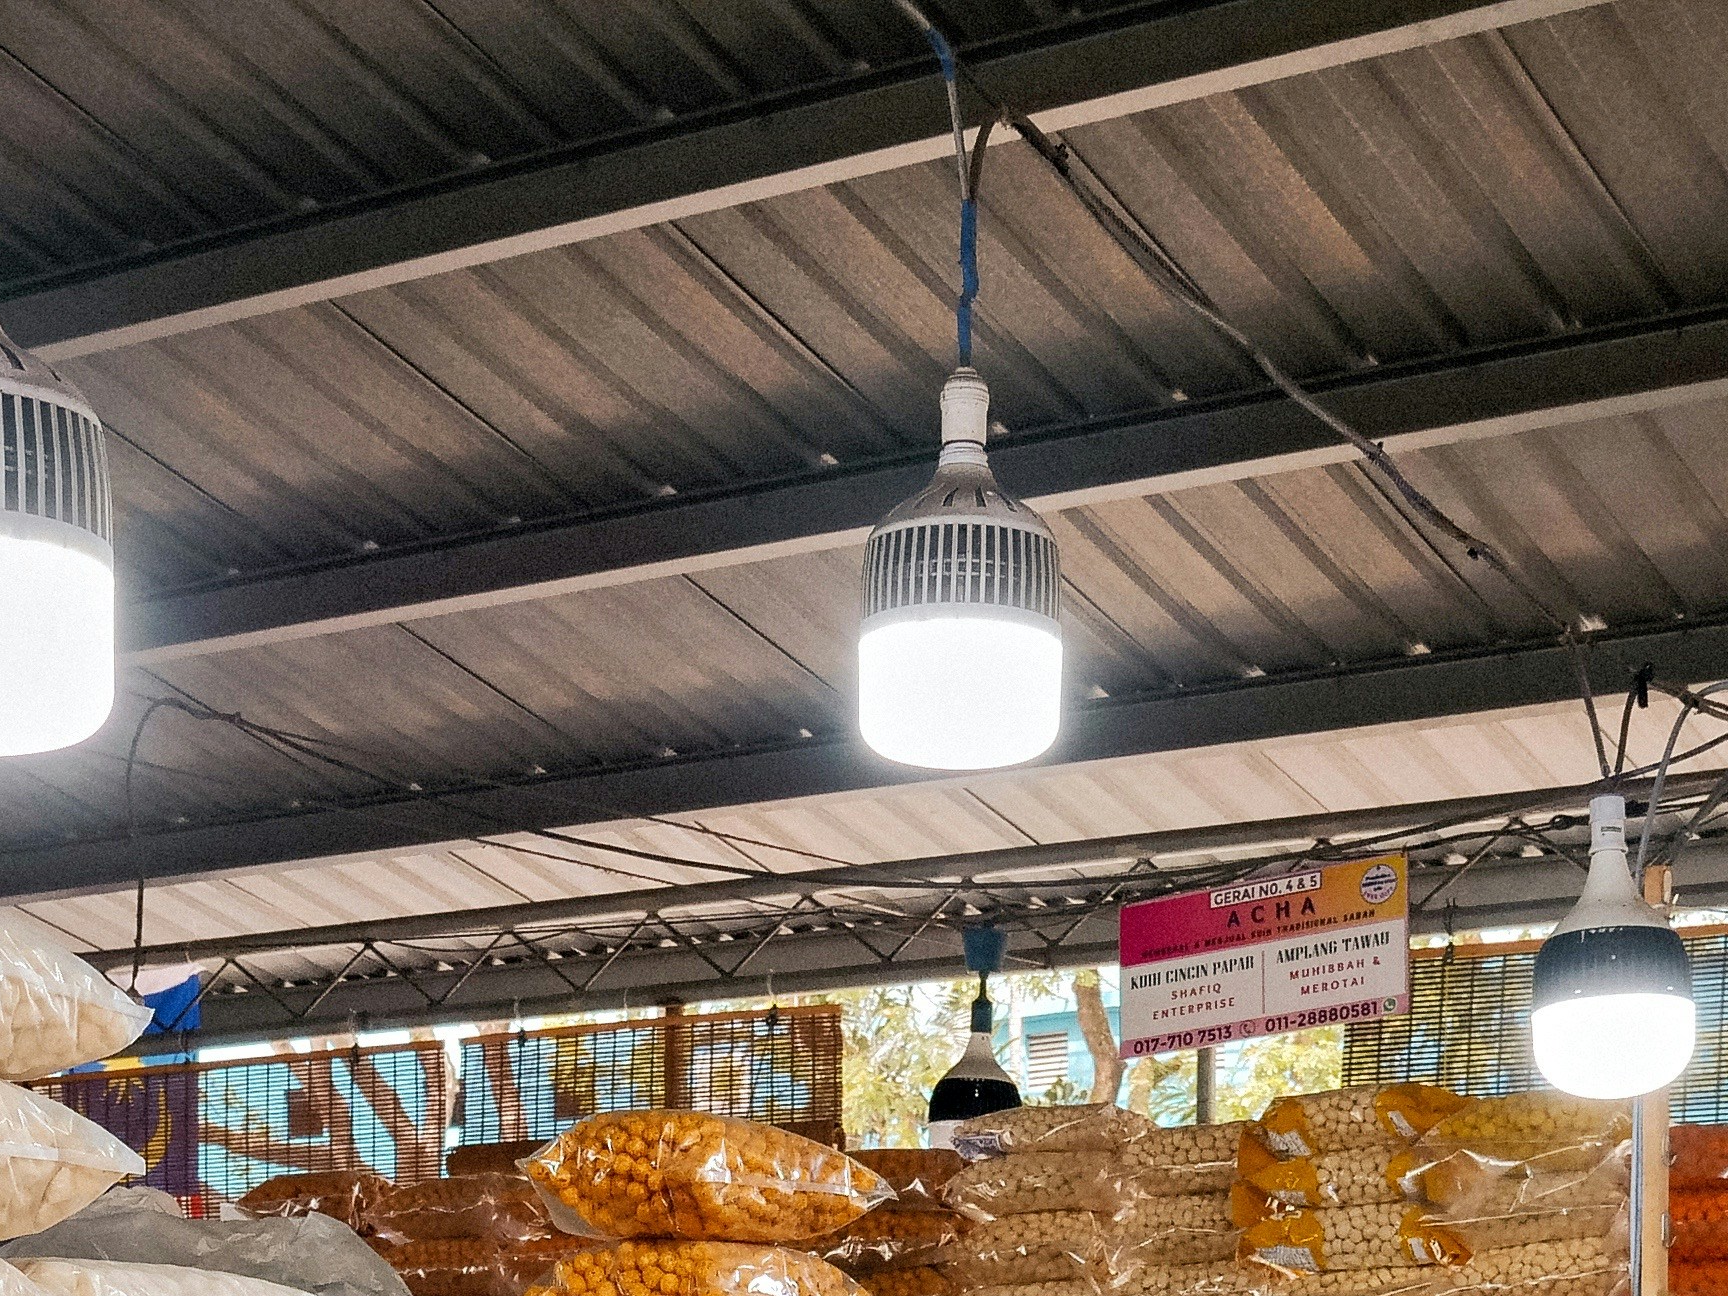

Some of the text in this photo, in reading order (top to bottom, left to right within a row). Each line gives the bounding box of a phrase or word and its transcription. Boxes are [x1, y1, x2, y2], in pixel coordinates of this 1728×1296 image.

[1214, 874, 1318, 905] GERAI NO. 4 & 5
[1226, 896, 1316, 928] ACHA
[1276, 916, 1339, 934] TRADISIONAL
[1343, 908, 1376, 923] SABAH
[1275, 930, 1391, 965] AMPLANG TAWAU
[1130, 955, 1255, 990] KUIH CINCIN PAPAR
[1289, 956, 1381, 981] MUHIBBAH &
[1171, 983, 1223, 1001] SHAFIQ
[1300, 976, 1366, 996] MEROTAI
[1152, 997, 1236, 1020] ENTERPRISE
[1264, 1001, 1379, 1032] 011-28880581
[1133, 1024, 1232, 1055] 017-710 7513
